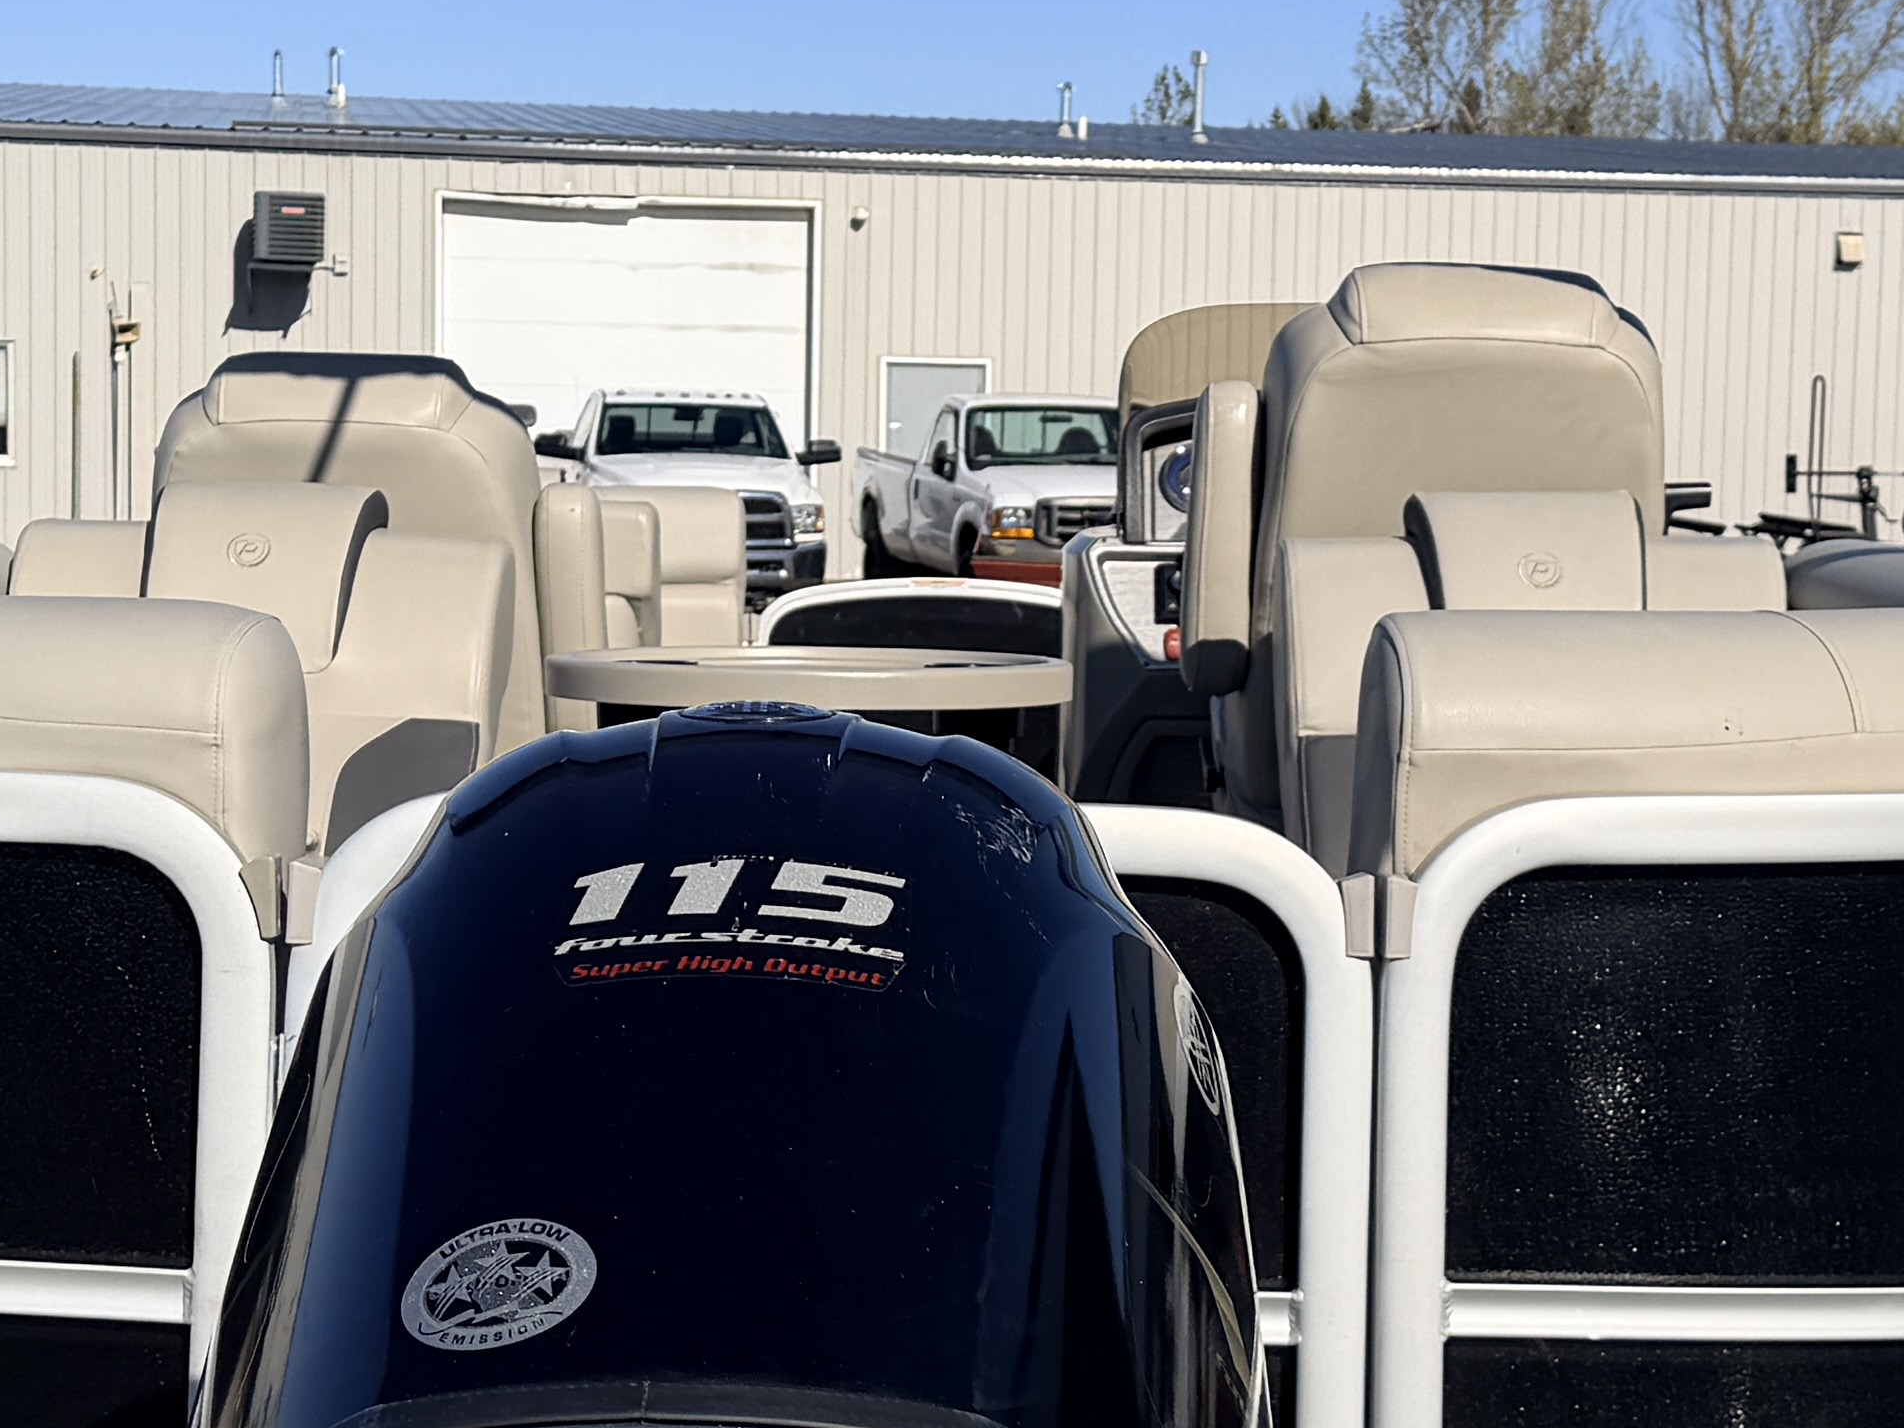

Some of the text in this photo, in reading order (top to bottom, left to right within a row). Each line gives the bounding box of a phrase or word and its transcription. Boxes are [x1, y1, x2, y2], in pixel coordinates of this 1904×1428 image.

[569, 859, 907, 927] 115
[570, 955, 886, 985] Super High Output
[439, 1318, 545, 1346] EMISSION
